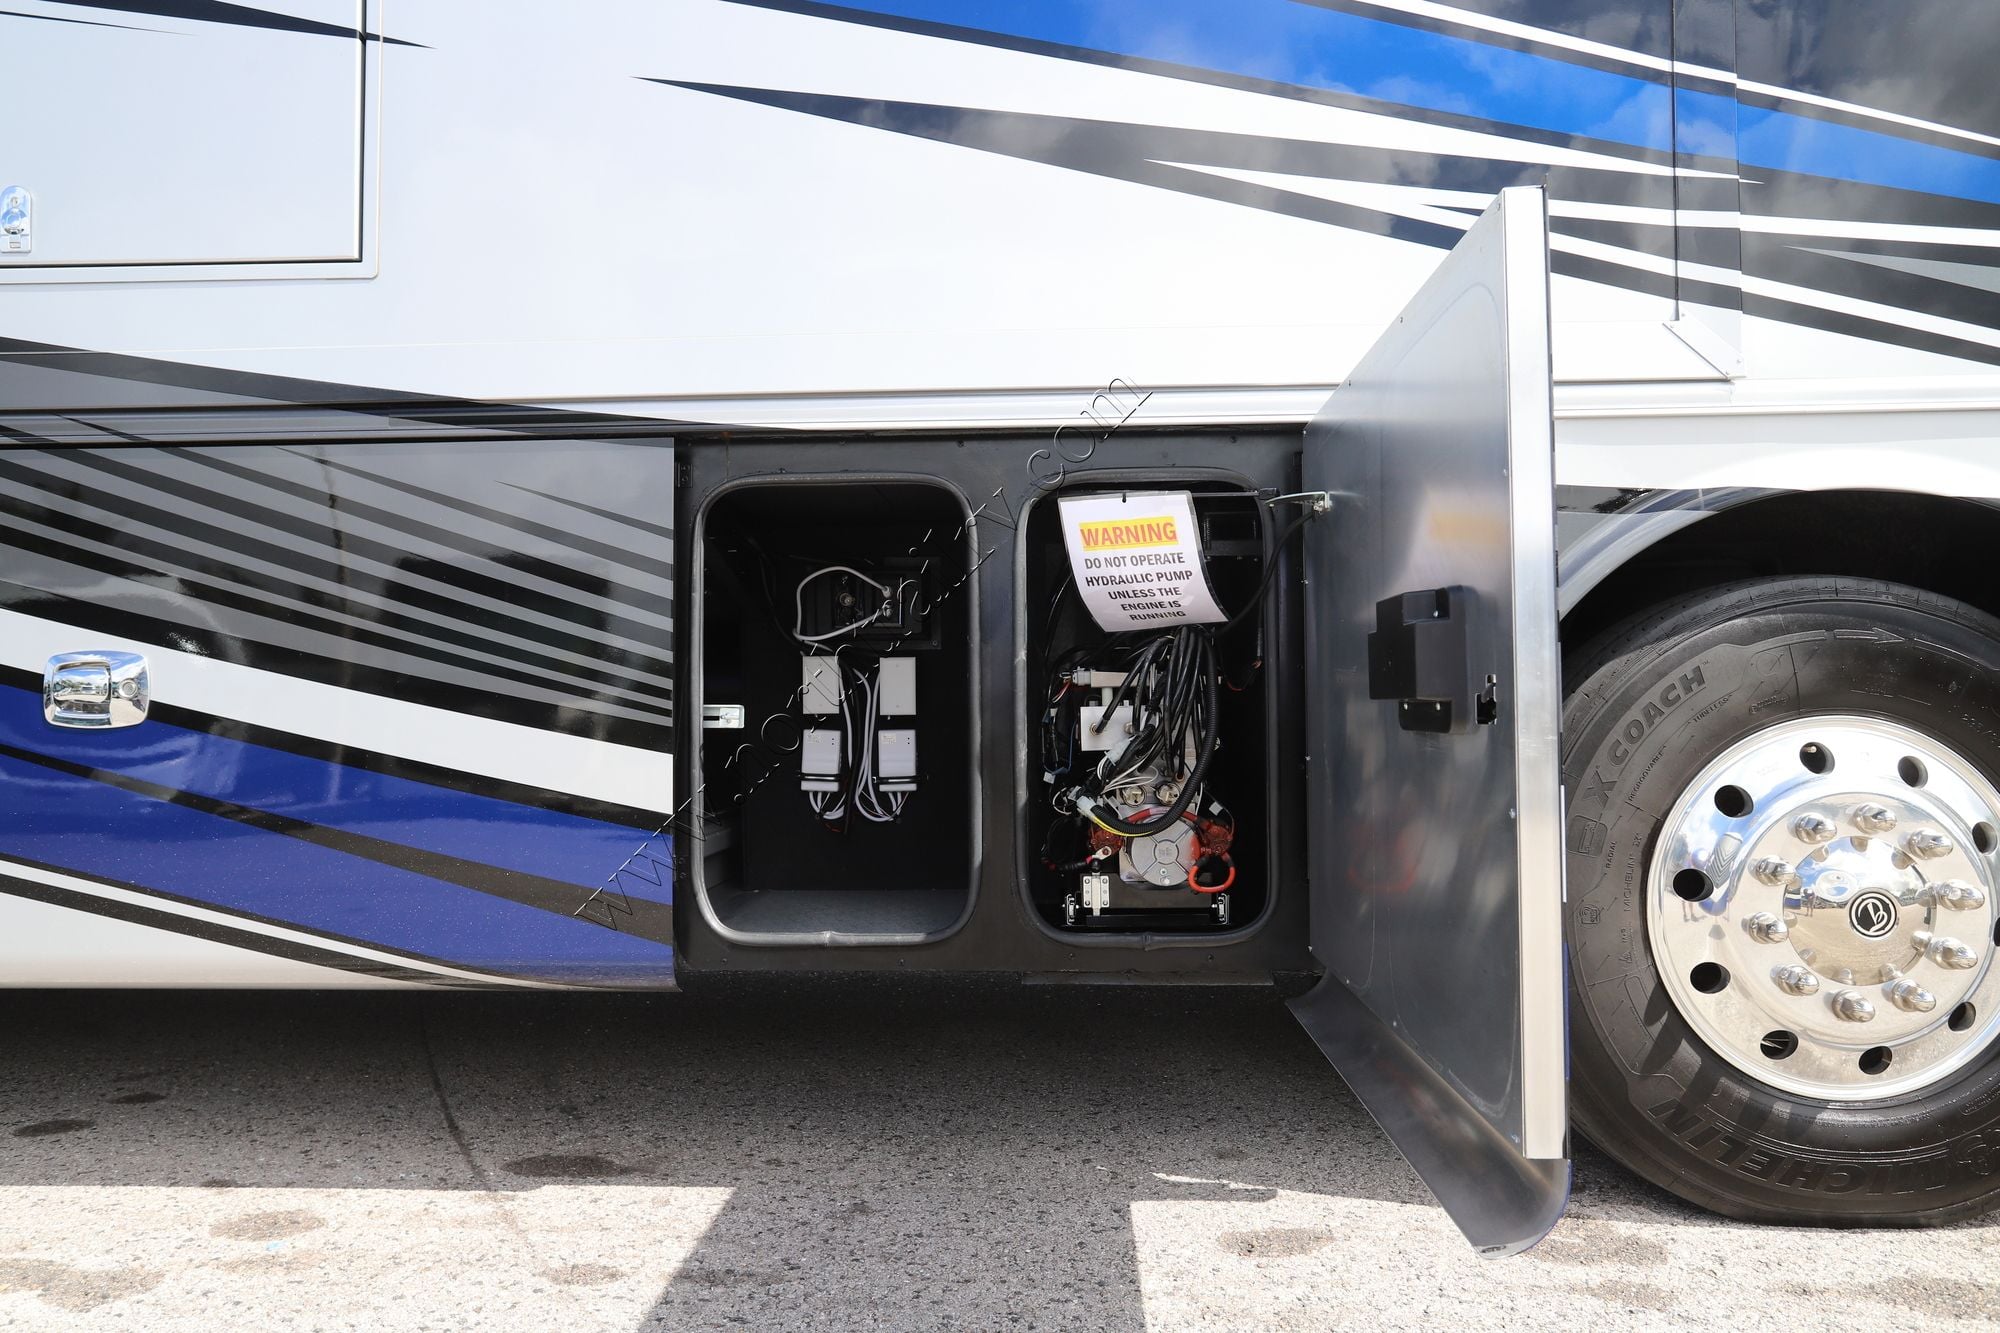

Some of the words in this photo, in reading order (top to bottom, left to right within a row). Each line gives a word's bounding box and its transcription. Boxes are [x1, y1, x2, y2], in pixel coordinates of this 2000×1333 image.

[1080, 523, 1177, 546] WARNING
[1085, 557, 1102, 569] DO
[1104, 556, 1127, 568] NOT
[1130, 552, 1186, 567] OPERATE
[1085, 573, 1154, 587] HYDRAULIC
[1156, 570, 1193, 582] PUMP
[1108, 589, 1156, 600] UNLESS
[1159, 587, 1182, 597] THE
[1120, 601, 1167, 611] ENGINE
[1169, 600, 1182, 608] IS
[1129, 611, 1186, 621] RUNNING
[1607, 664, 1706, 768] COACH
[1605, 841, 1617, 869] RADIAL
[1623, 855, 1635, 912] MICHELIN
[1647, 1098, 1945, 1196] MICHELIN
